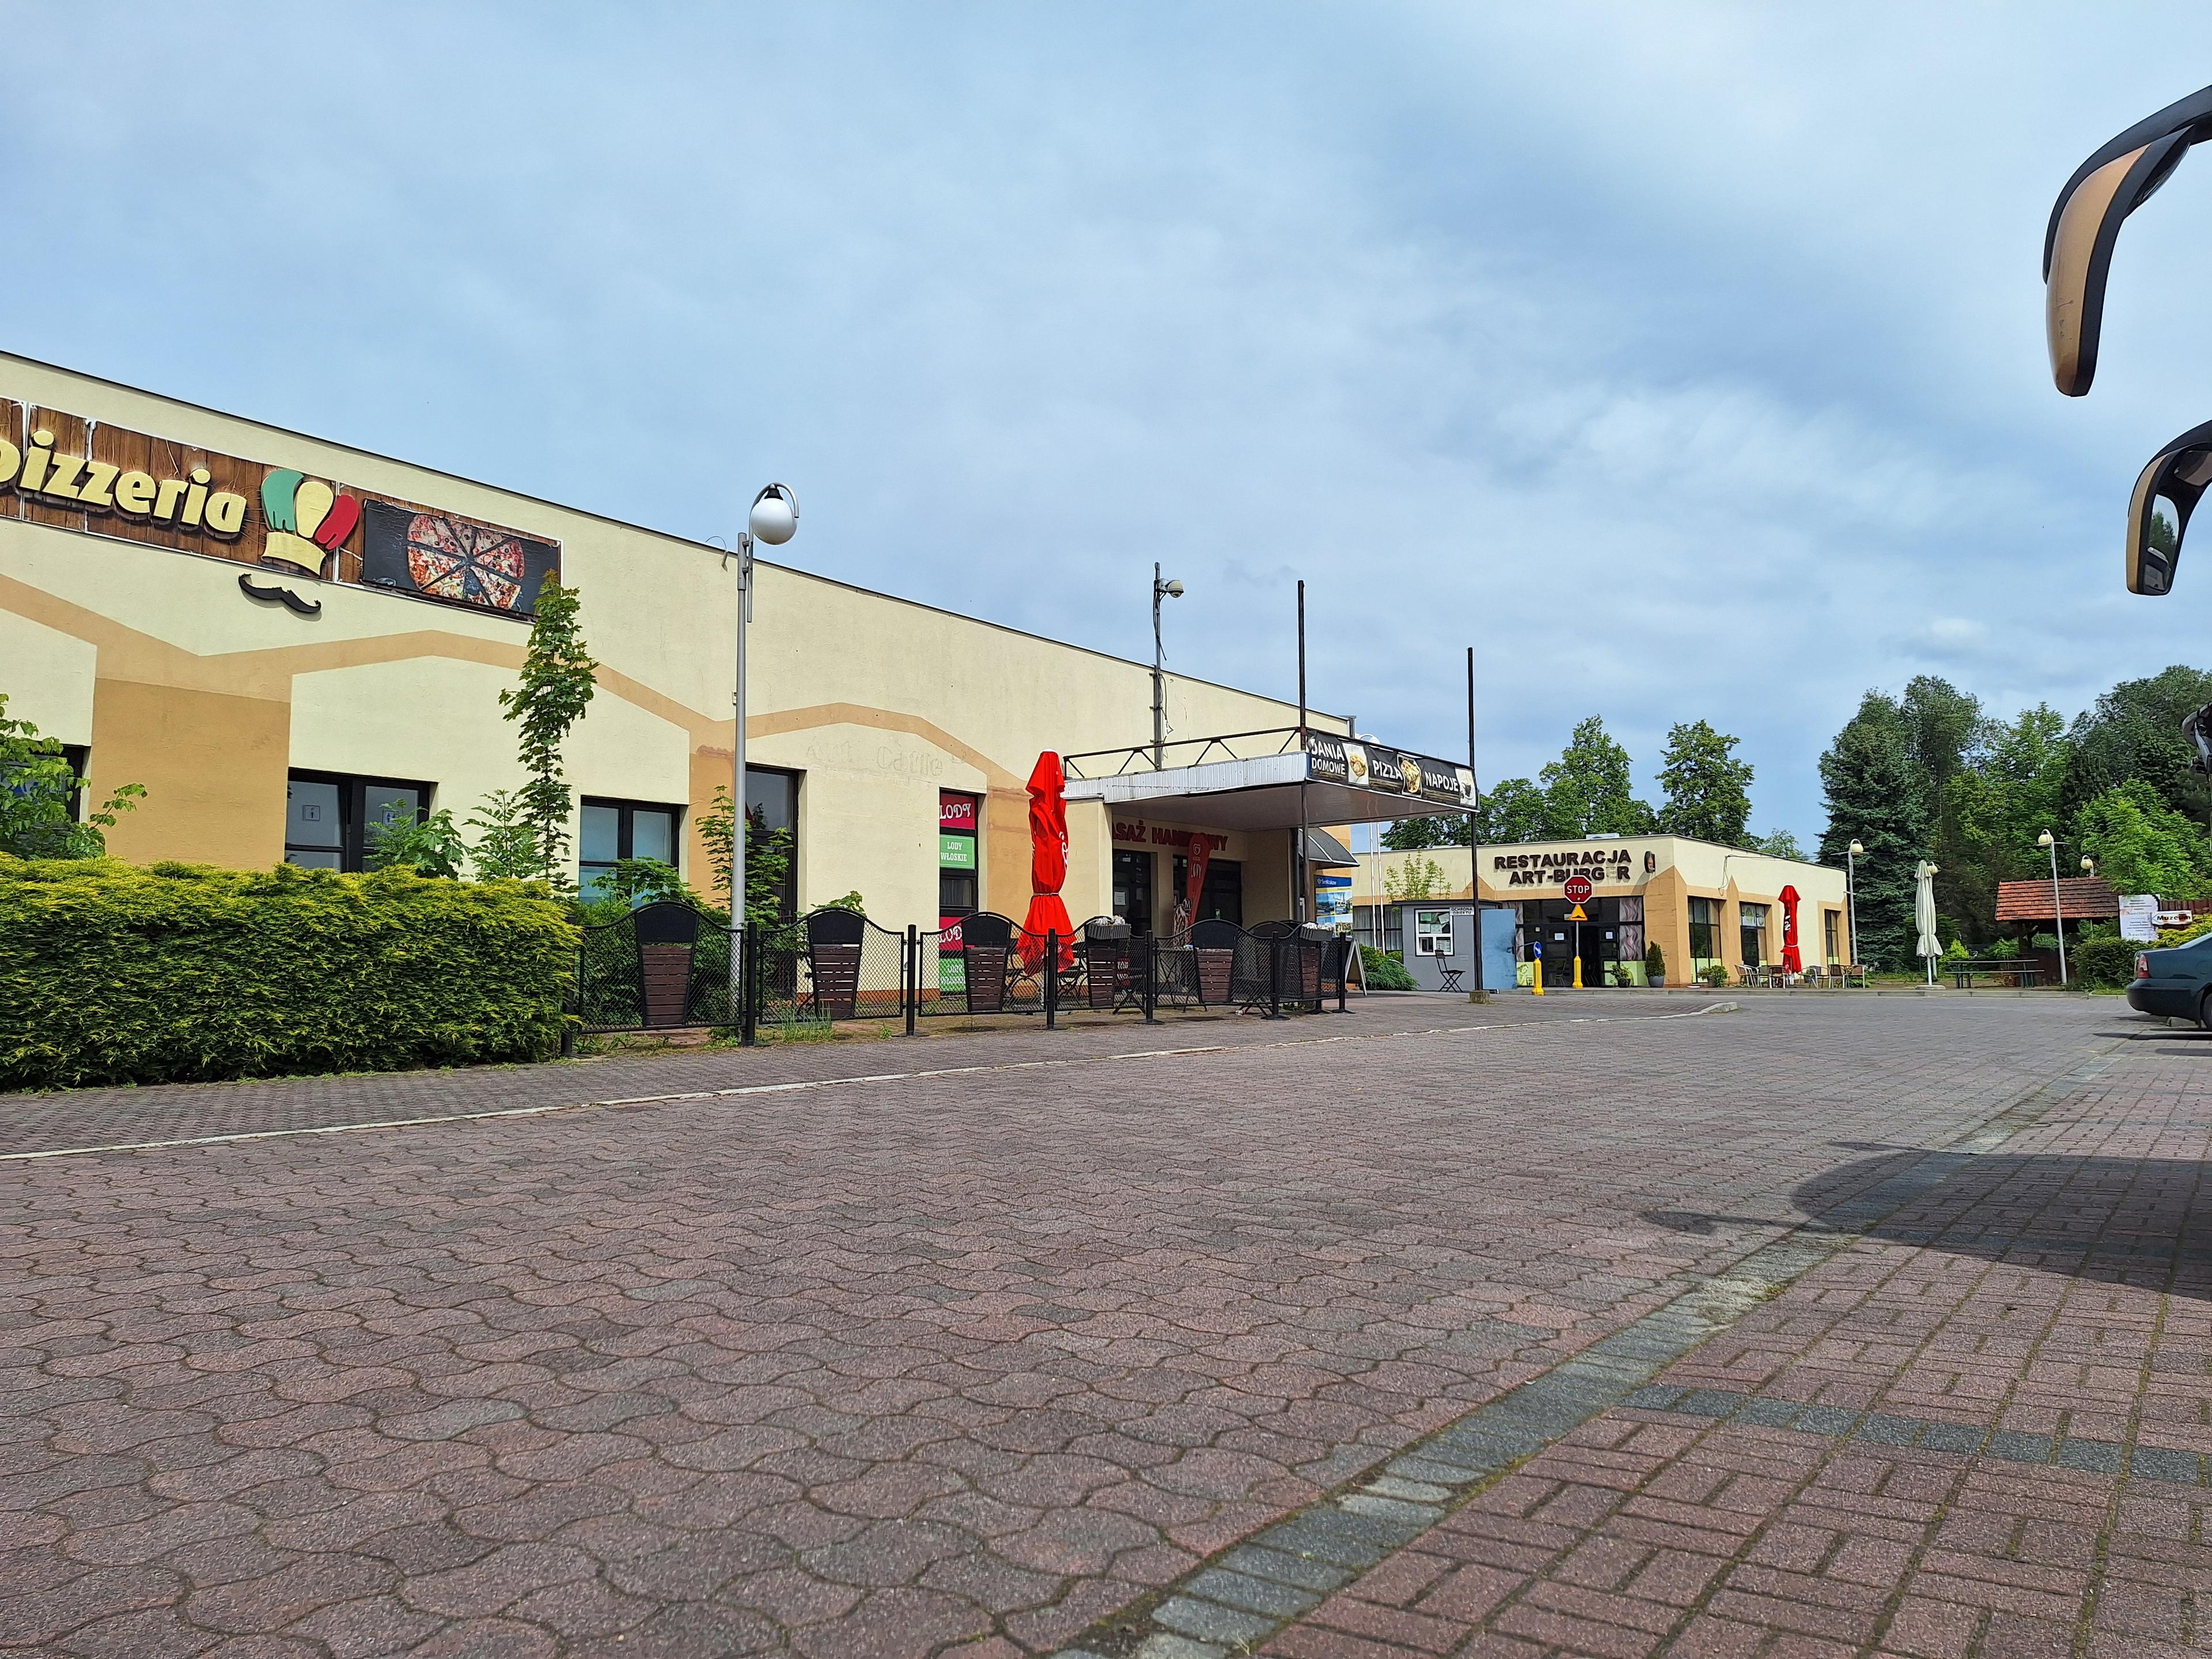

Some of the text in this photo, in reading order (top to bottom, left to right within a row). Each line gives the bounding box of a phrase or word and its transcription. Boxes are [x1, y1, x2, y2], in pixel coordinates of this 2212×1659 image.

[1311, 757, 1346, 775] DOMOWE
[1372, 760, 1403, 781] PIZZA
[1424, 771, 1459, 792] NAPOJE
[940, 803, 972, 819] LODY
[947, 842, 963, 850] LODY
[940, 852, 967, 862] WŁOSKIE
[1494, 849, 1632, 870] RESTAURACJA
[1567, 885, 1590, 894] STOP
[939, 925, 962, 943] LOD
